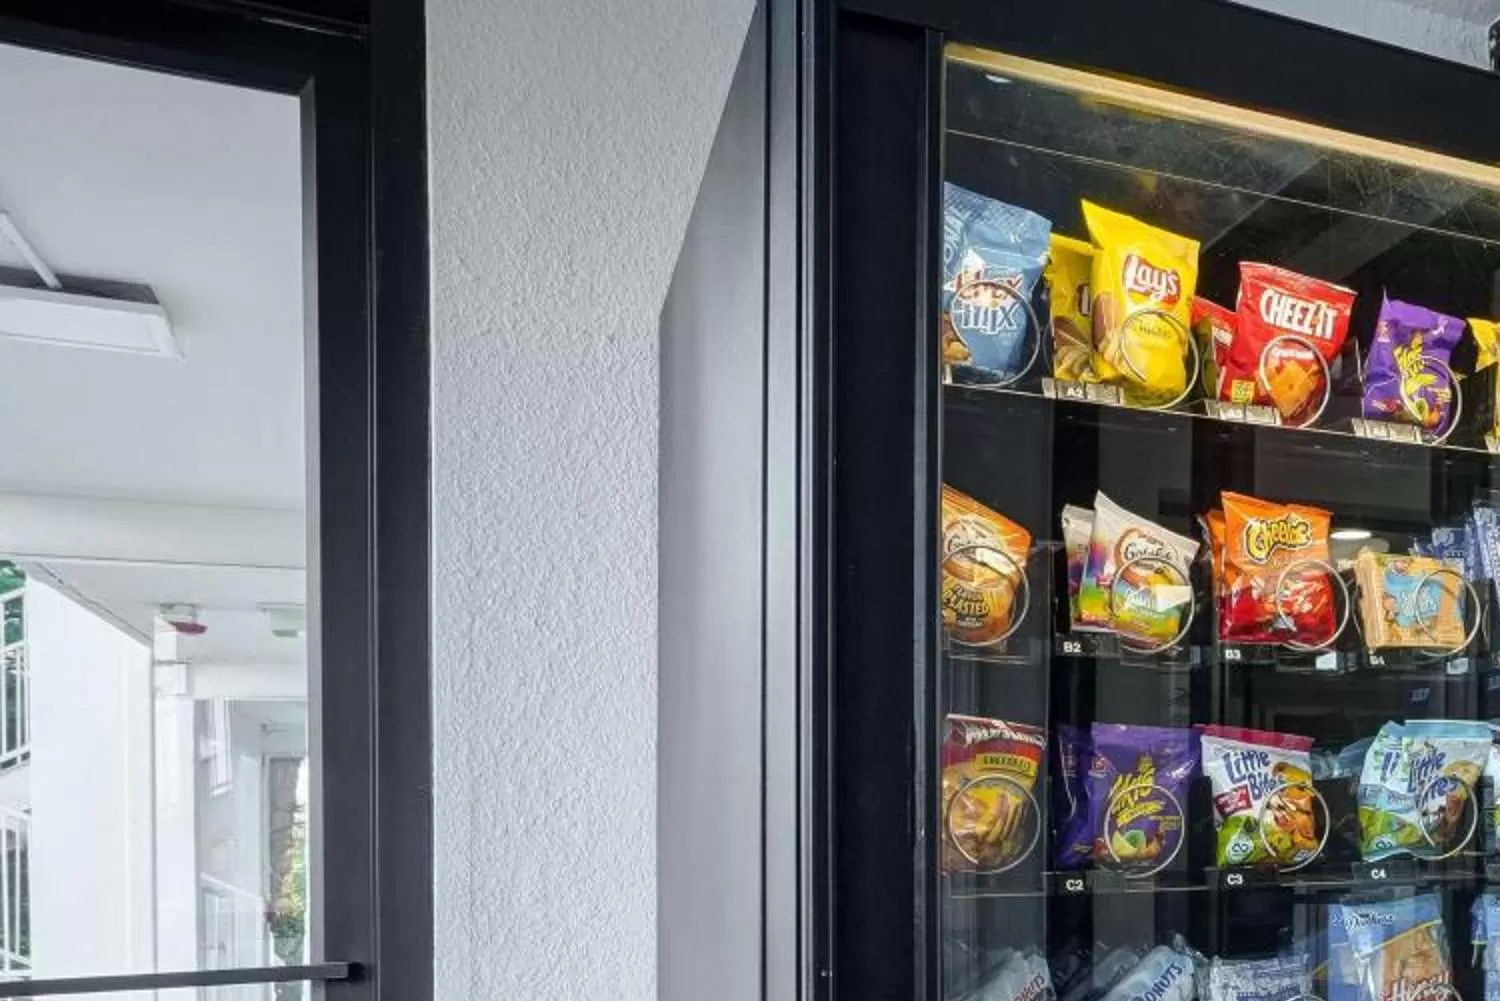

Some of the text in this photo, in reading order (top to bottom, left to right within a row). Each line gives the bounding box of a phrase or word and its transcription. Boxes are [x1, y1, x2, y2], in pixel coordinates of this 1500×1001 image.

[1124, 255, 1179, 300] Lay's
[1260, 288, 1337, 340] CHEEZ-IT
[1244, 516, 1313, 563] Cheetos
[1064, 641, 1081, 653] B2
[1222, 750, 1271, 784] Little
[1066, 879, 1084, 891] C2
[1227, 873, 1244, 885] C3
[1371, 868, 1387, 879] C4
